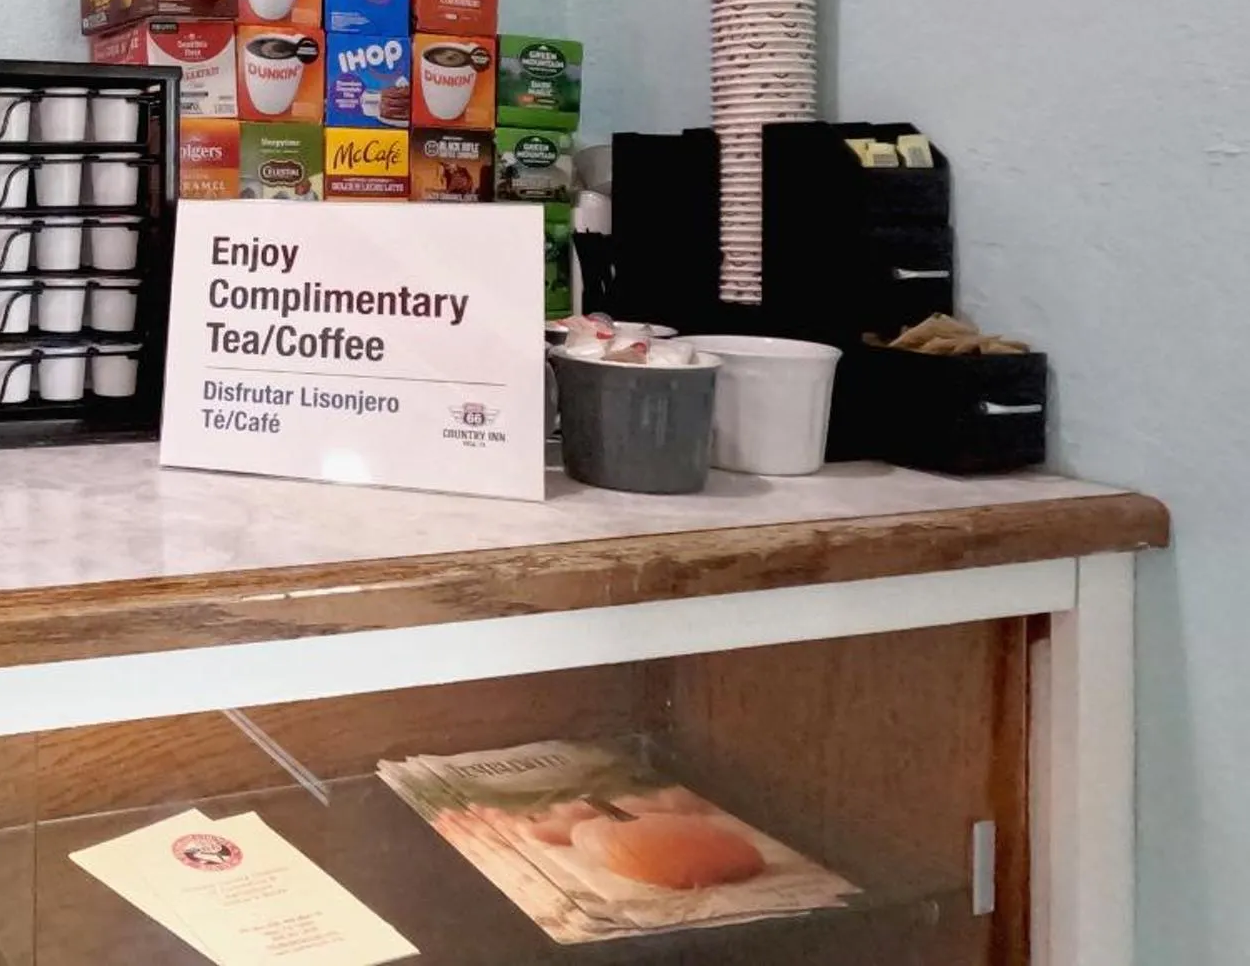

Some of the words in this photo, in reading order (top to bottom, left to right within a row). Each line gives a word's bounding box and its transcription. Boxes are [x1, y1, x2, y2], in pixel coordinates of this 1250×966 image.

[338, 40, 403, 73] IHOP
[180, 144, 223, 162] olgers
[332, 139, 400, 171] McCafé
[211, 236, 299, 274] Enjoy
[208, 278, 469, 326] Complimentary
[206, 322, 385, 362] Tea/Coffee
[203, 380, 294, 406] Disfrutar
[300, 386, 400, 415] Lisonjero
[202, 408, 281, 434] Té/Café
[443, 428, 485, 440] COUNTRY
[487, 431, 506, 443] INN
